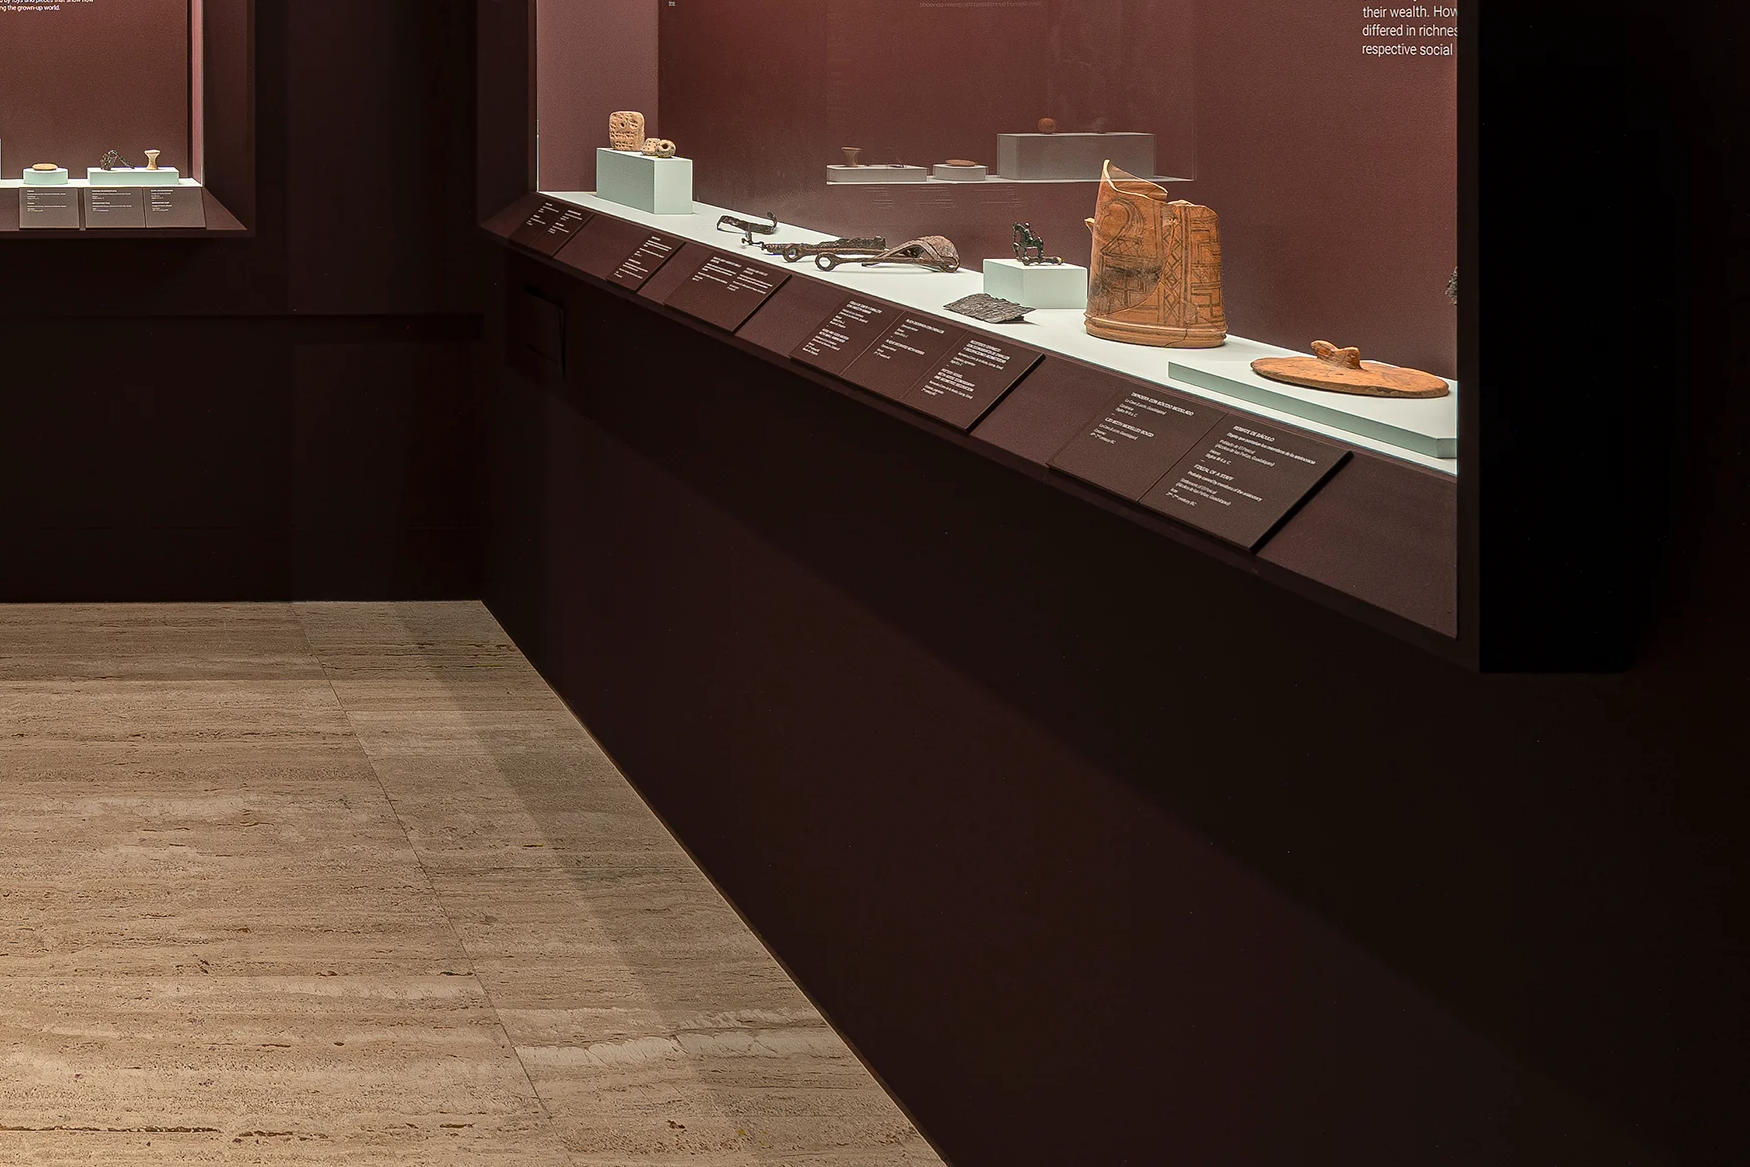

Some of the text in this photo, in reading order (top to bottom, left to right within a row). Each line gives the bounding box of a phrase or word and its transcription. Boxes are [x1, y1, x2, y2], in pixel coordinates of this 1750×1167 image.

[1362, 5, 1387, 18] their
[1389, 4, 1430, 17] wealth.
[1362, 23, 1402, 36] differed
[1406, 23, 1415, 36] in
[1361, 42, 1453, 58] respective social
